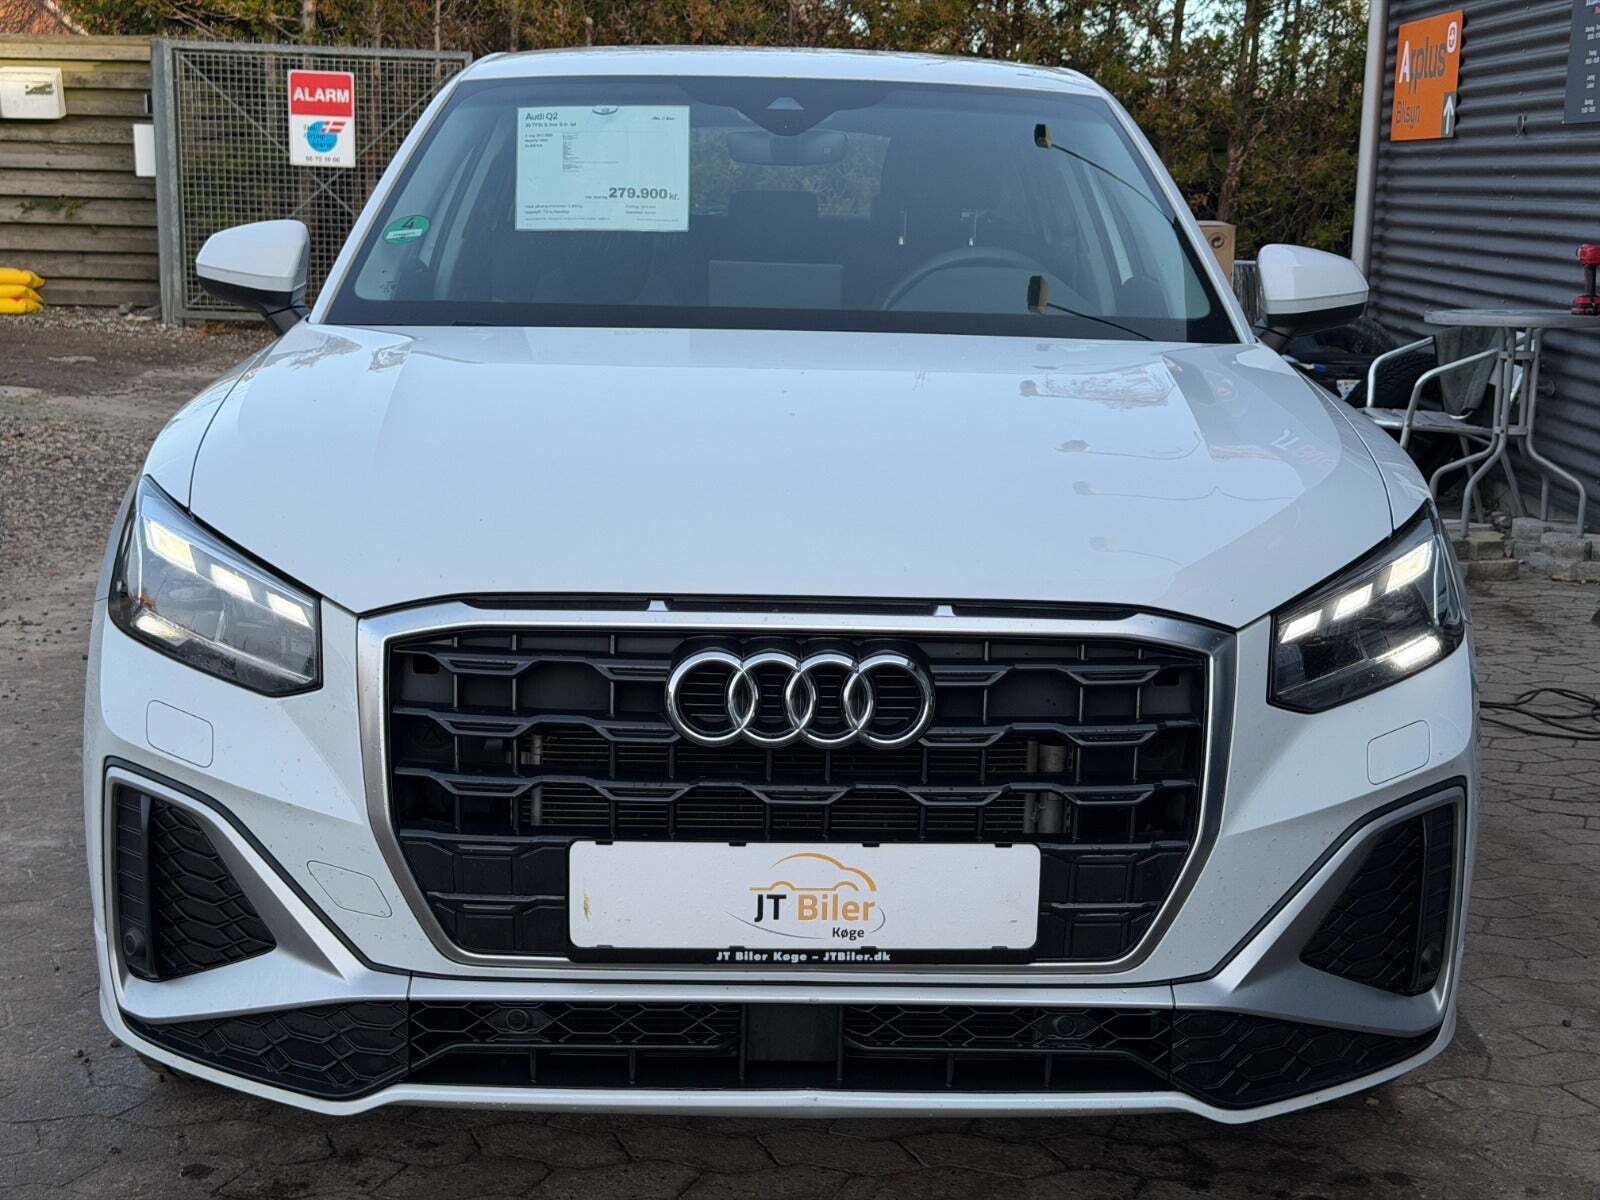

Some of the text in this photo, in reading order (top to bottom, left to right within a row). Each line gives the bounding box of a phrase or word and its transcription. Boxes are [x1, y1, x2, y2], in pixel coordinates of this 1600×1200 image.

[293, 86, 350, 103] ALARM
[525, 112, 558, 121] Audi Q2
[608, 186, 669, 200] 279.900
[669, 191, 681, 201] kr.
[401, 216, 416, 230] 4
[754, 894, 876, 923] JT Biler
[832, 927, 865, 941] Køge
[716, 951, 731, 961] JT
[735, 951, 768, 961] Biler
[773, 951, 807, 963] Køge
[823, 951, 891, 961] JTBiler.dk
